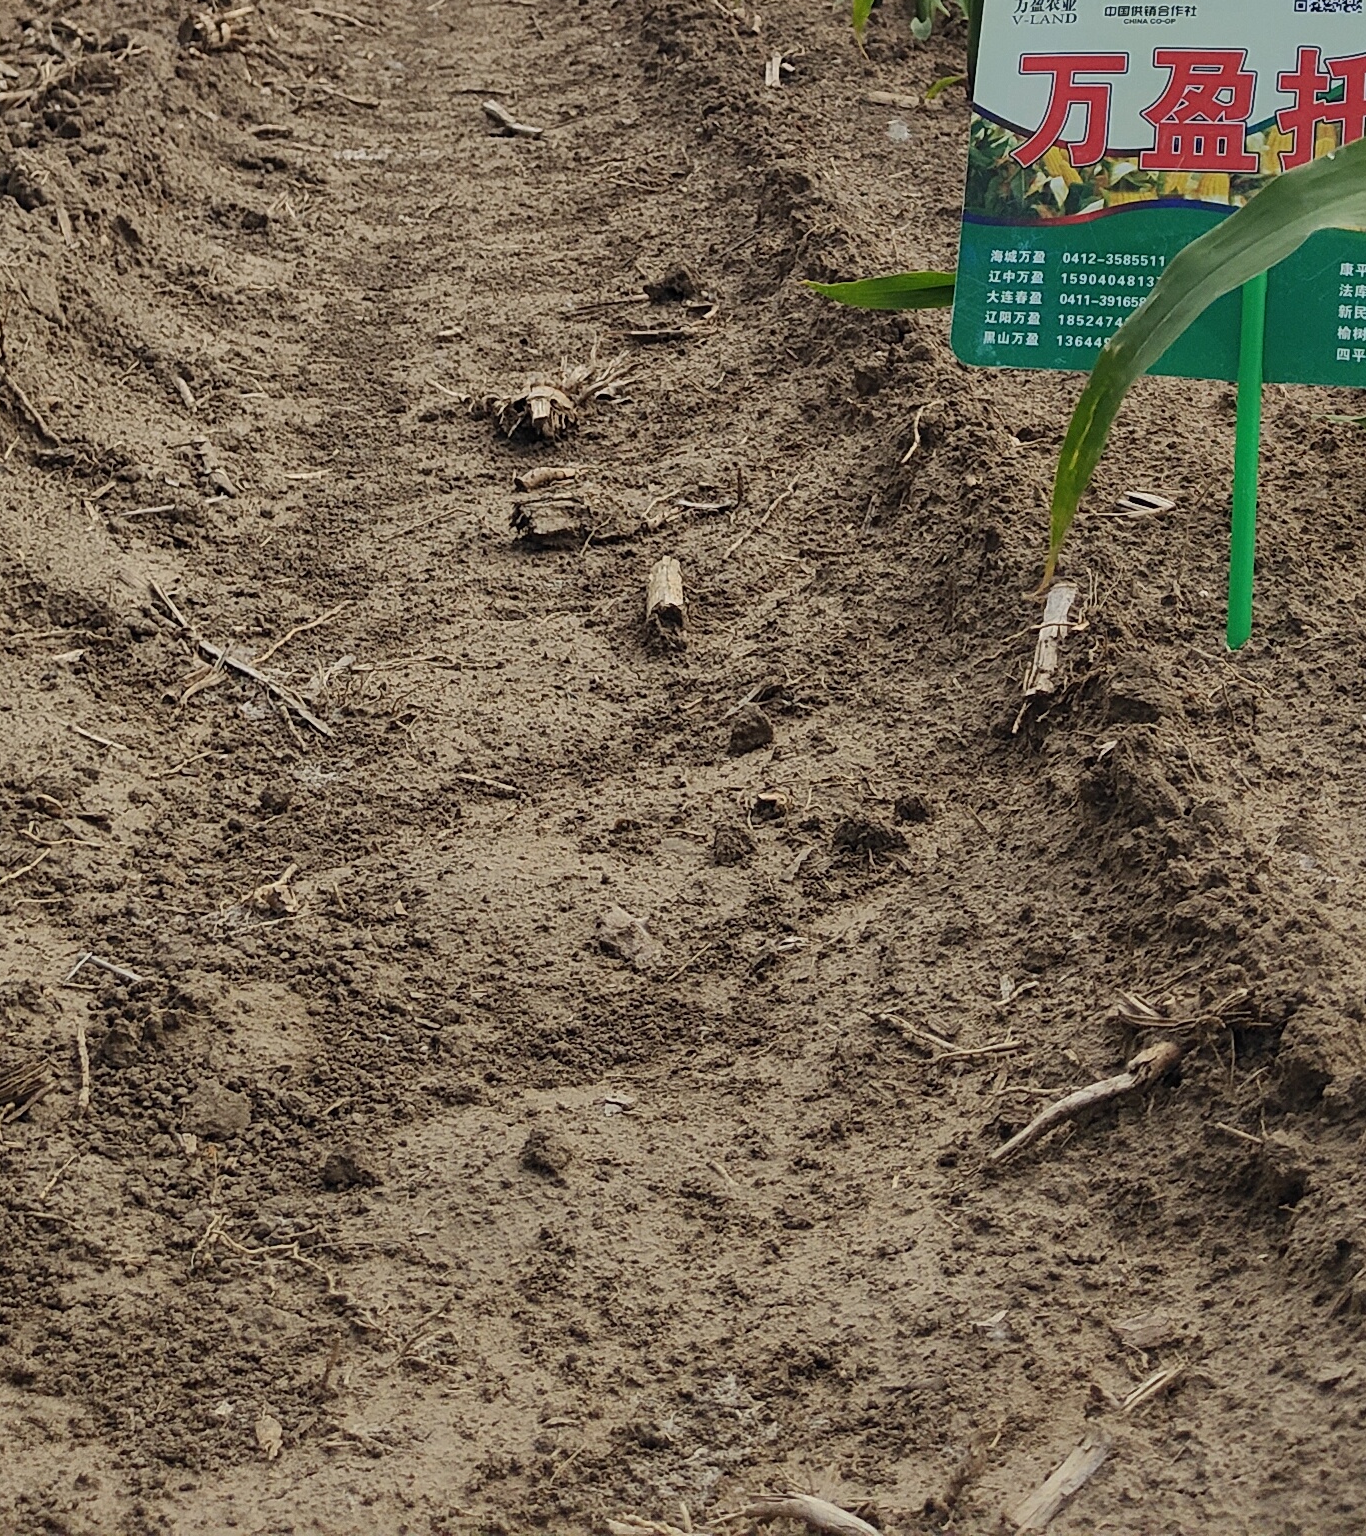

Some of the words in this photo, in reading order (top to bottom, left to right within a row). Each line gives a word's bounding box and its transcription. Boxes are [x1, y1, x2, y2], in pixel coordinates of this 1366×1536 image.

[1012, 13, 1077, 25] V-LAND
[1104, 5, 1198, 17] 中国供销合作社
[990, 250, 1046, 264] 海城万盈
[1062, 252, 1166, 267] 0412-3585511
[988, 270, 1044, 284] 辽中万盈
[1061, 273, 1162, 288] 1590404813
[986, 290, 1043, 305] 大连春盈
[1059, 294, 1148, 308] 0411-391658
[984, 310, 1041, 326] 辽阳万盈
[1058, 314, 1129, 328] 1852474
[983, 331, 1039, 346] 黑山万盈
